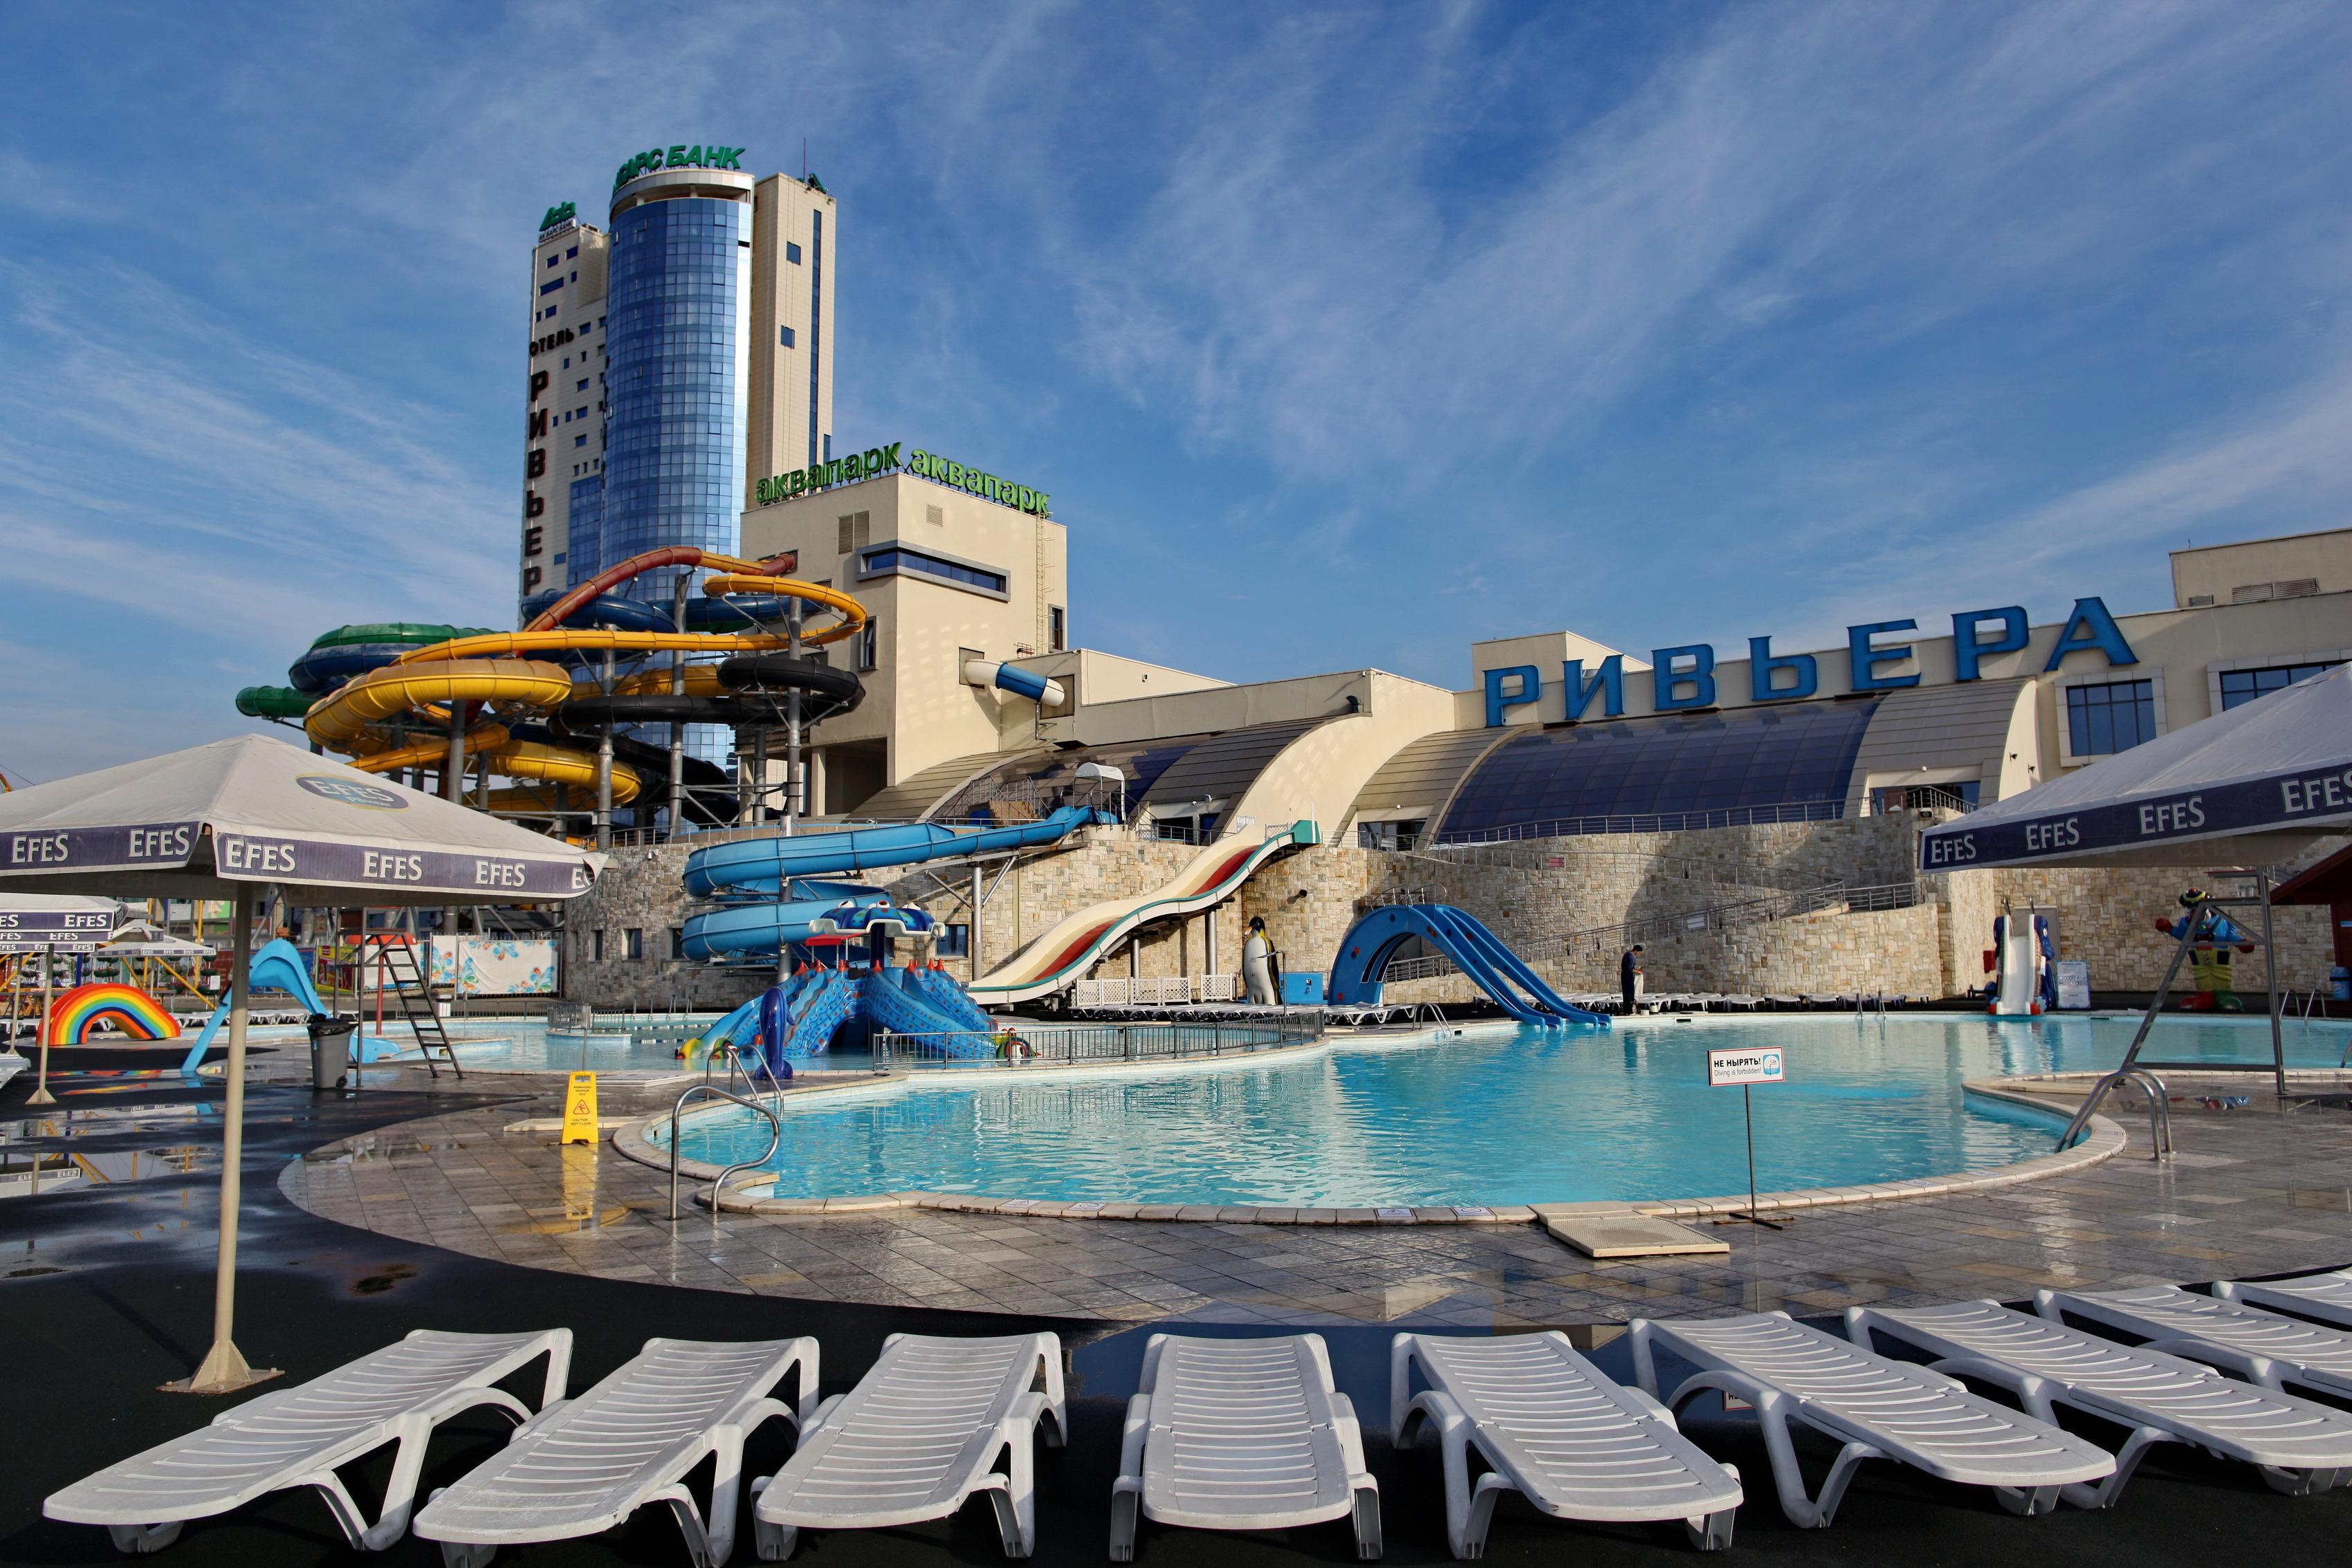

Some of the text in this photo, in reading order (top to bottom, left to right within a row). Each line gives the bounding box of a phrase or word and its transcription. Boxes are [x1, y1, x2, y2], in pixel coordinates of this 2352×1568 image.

[665, 145, 746, 169] БАНК
[529, 327, 574, 357] ОТЕЛЬ
[755, 442, 902, 503] аквапарк
[910, 448, 1051, 513] аквапарк
[1482, 596, 2140, 728] РИВЬЕРА
[305, 780, 394, 802] EFES
[2138, 795, 2205, 835] EFES
[11, 826, 190, 863] EFES EFES
[1930, 834, 1976, 864] EFES
[2026, 818, 2079, 851] EFES
[226, 838, 526, 887] EFES EFES EFES
[64, 914, 107, 928] EFES
[1727, 1058, 1761, 1067] НЫРЯТЬ!
[1736, 1067, 1762, 1075] forbidden!
